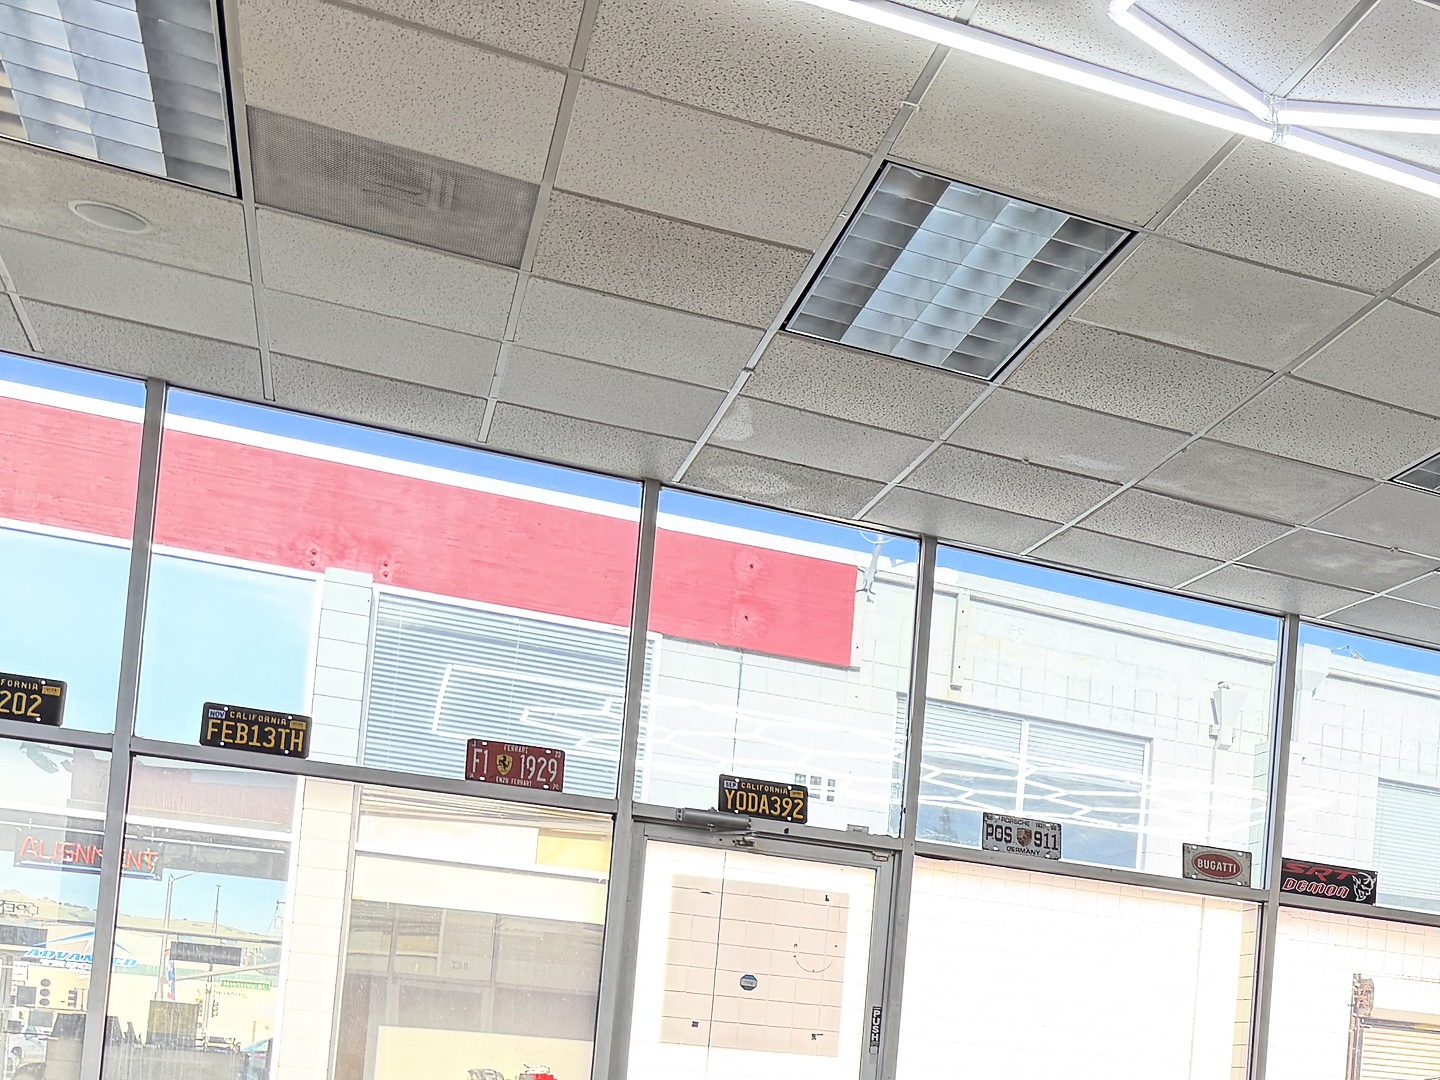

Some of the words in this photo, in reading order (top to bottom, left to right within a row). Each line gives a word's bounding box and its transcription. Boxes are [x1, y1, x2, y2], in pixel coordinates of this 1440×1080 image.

[229, 711, 287, 726] CALIFORNIA
[206, 718, 304, 752] FEB13TH
[503, 743, 529, 754] FERRARI
[472, 748, 489, 775] F1
[520, 753, 558, 783] 1929
[741, 782, 788, 795] CALIFORNIA
[725, 788, 804, 819] YODA392
[1006, 845, 1041, 856] GERMANY
[1033, 830, 1059, 851] 911
[19, 836, 159, 870] ALIGNNT
[1197, 858, 1237, 874] BUGATTI
[1282, 862, 1359, 882] SRT
[25, 948, 138, 968] ADVANED
[871, 1009, 881, 1042] PUSH
